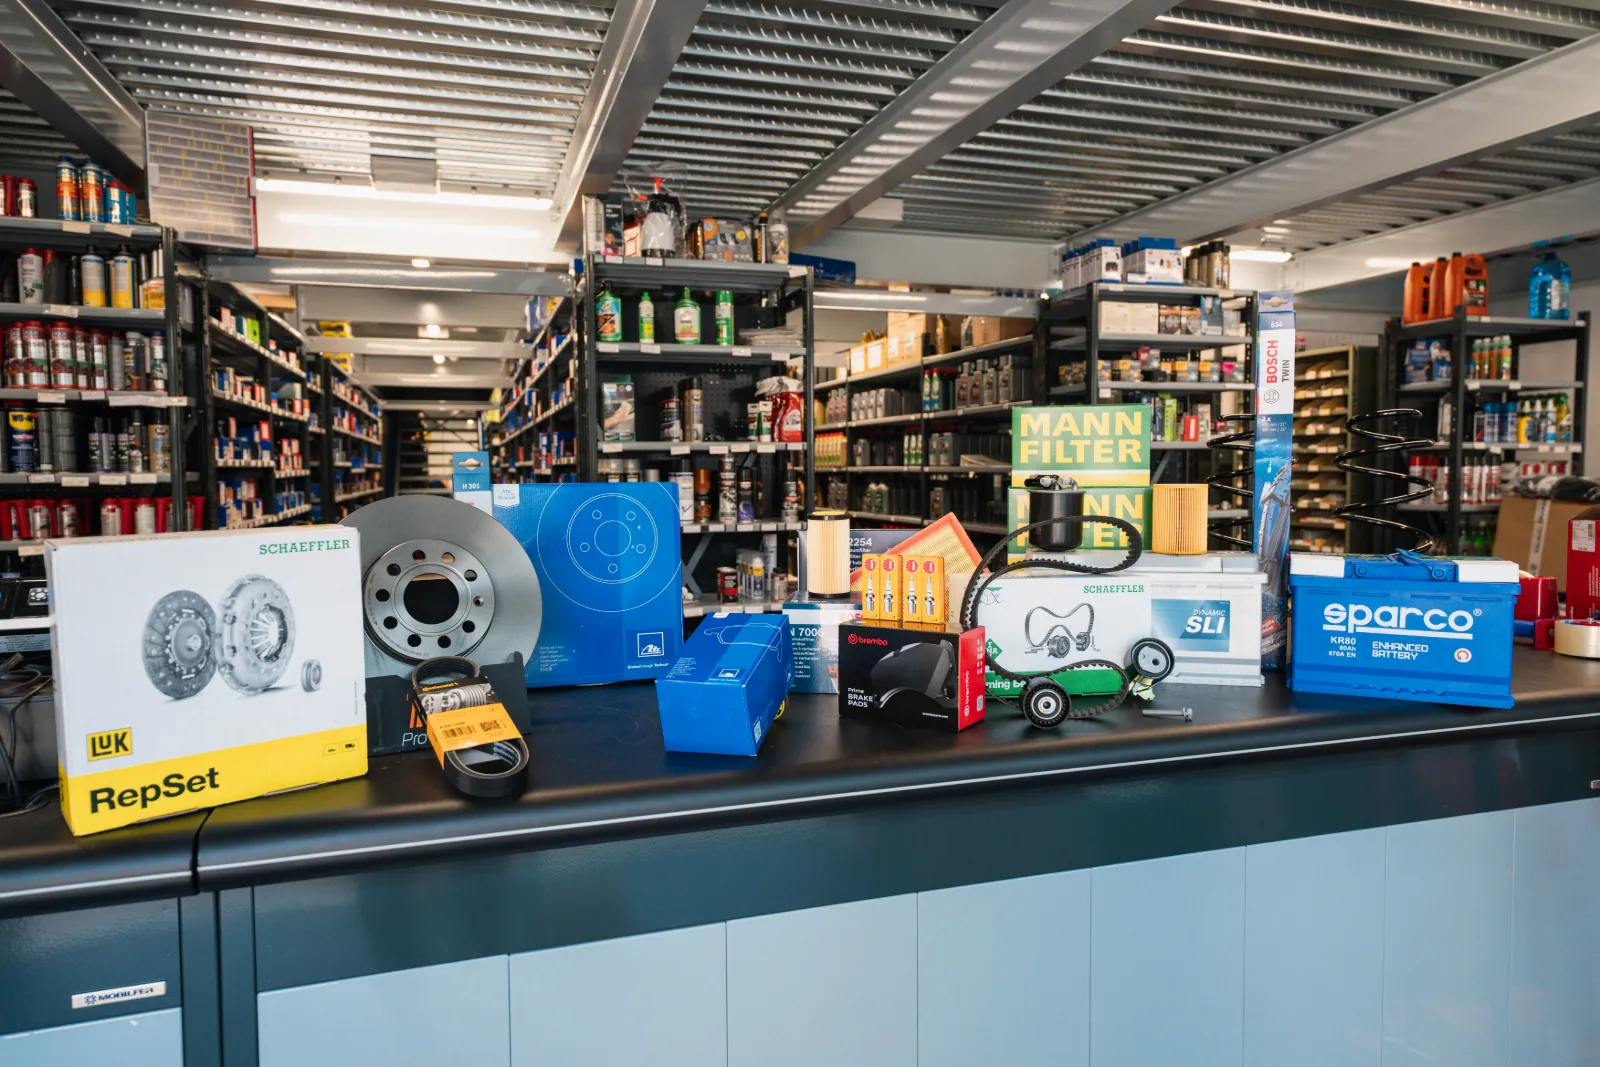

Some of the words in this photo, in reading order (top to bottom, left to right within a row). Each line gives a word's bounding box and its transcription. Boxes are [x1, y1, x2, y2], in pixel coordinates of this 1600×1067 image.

[1266, 339, 1278, 384] BOSCH
[1282, 359, 1290, 383] TWIN
[1020, 411, 1142, 437] MANN
[1020, 439, 1142, 464] FILTER
[468, 482, 480, 490] 301
[259, 539, 350, 555] SCHAEFFLER
[1083, 584, 1145, 594] SCHAEFFLER
[1193, 609, 1226, 617] DYNAMIC
[1185, 616, 1226, 634] SLI
[798, 627, 825, 637] 7006
[858, 636, 889, 646] brembo
[1330, 636, 1357, 645] KR80
[1372, 641, 1429, 653] ENHANCED
[1372, 649, 1419, 661] BATTERY
[848, 693, 874, 702] BRAKE
[848, 700, 869, 708] PADS
[401, 732, 428, 747] Pro
[89, 767, 220, 814] RepSet
[98, 987, 154, 1002] MOBILFER
